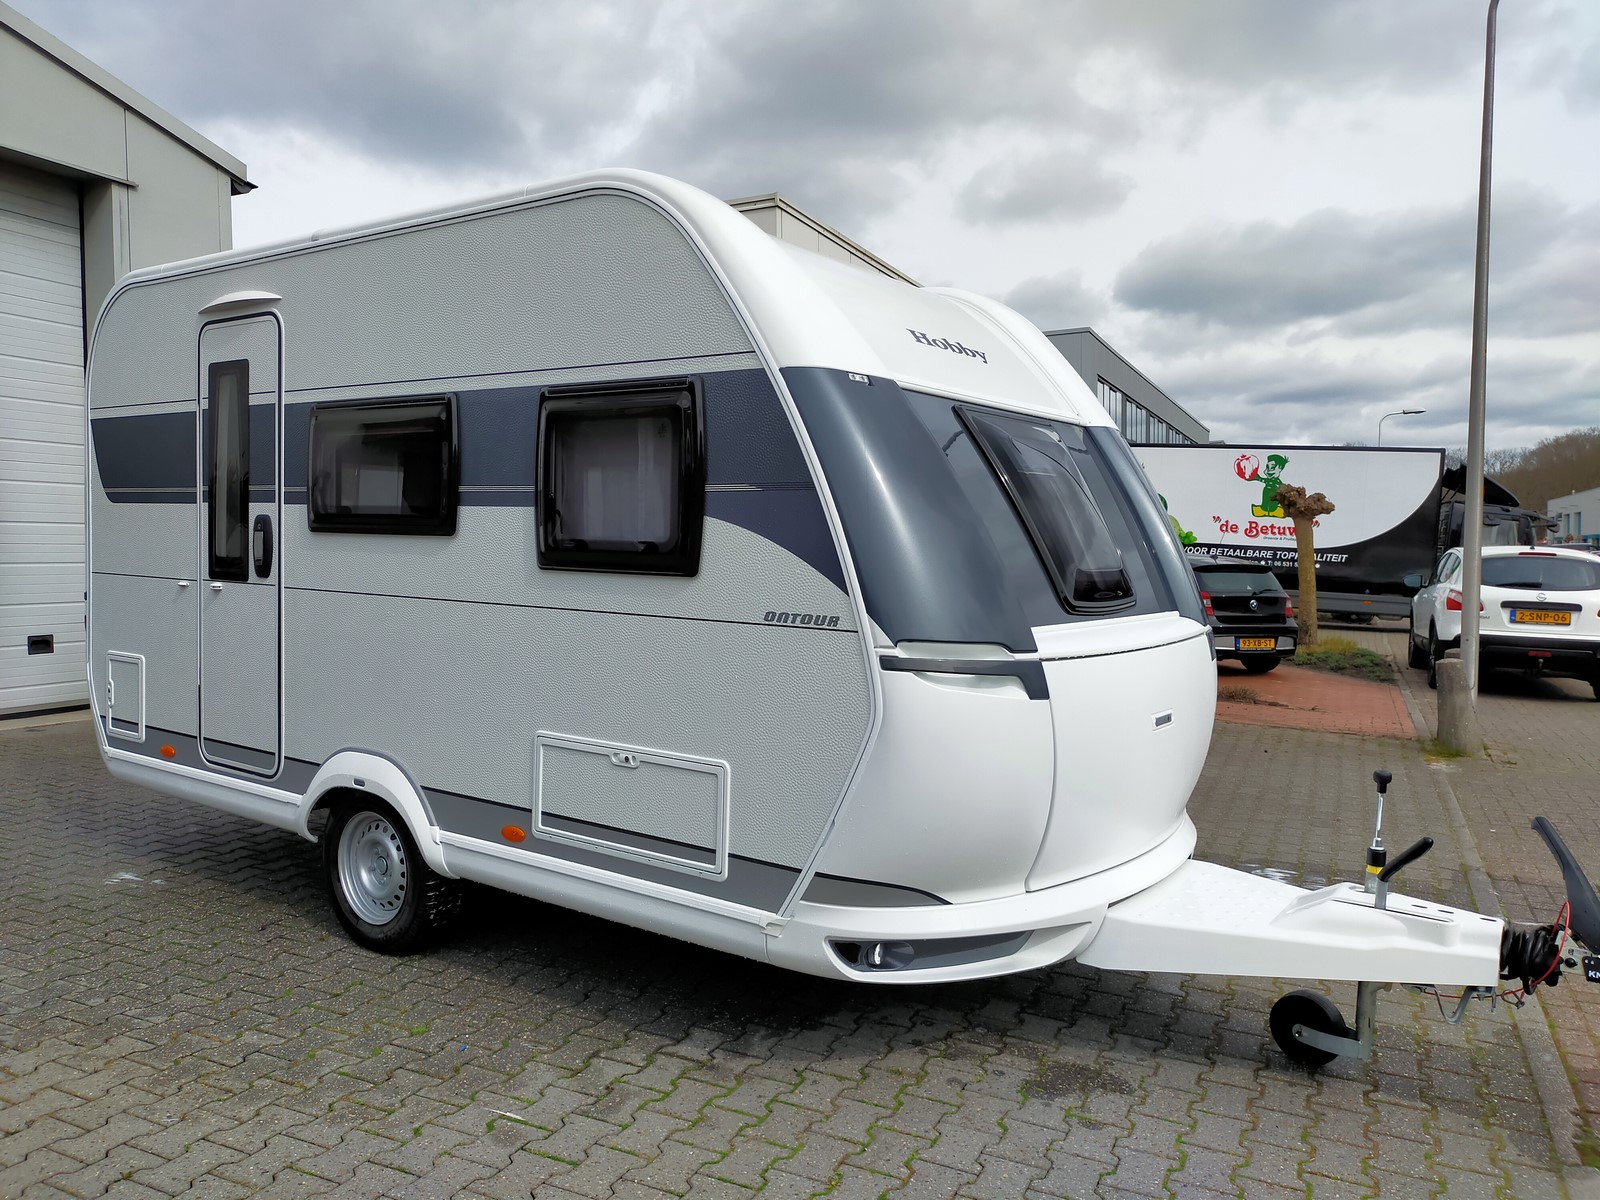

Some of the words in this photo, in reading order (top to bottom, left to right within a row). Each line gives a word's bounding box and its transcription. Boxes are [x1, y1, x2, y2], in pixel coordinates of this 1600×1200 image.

[906, 328, 988, 364] Hobby
[1210, 547, 1274, 559] BETAALBARE
[763, 611, 840, 627] ONTOUR
[1519, 612, 1567, 622] 2-SNP-06
[1242, 639, 1272, 647] 93-XB-ST
